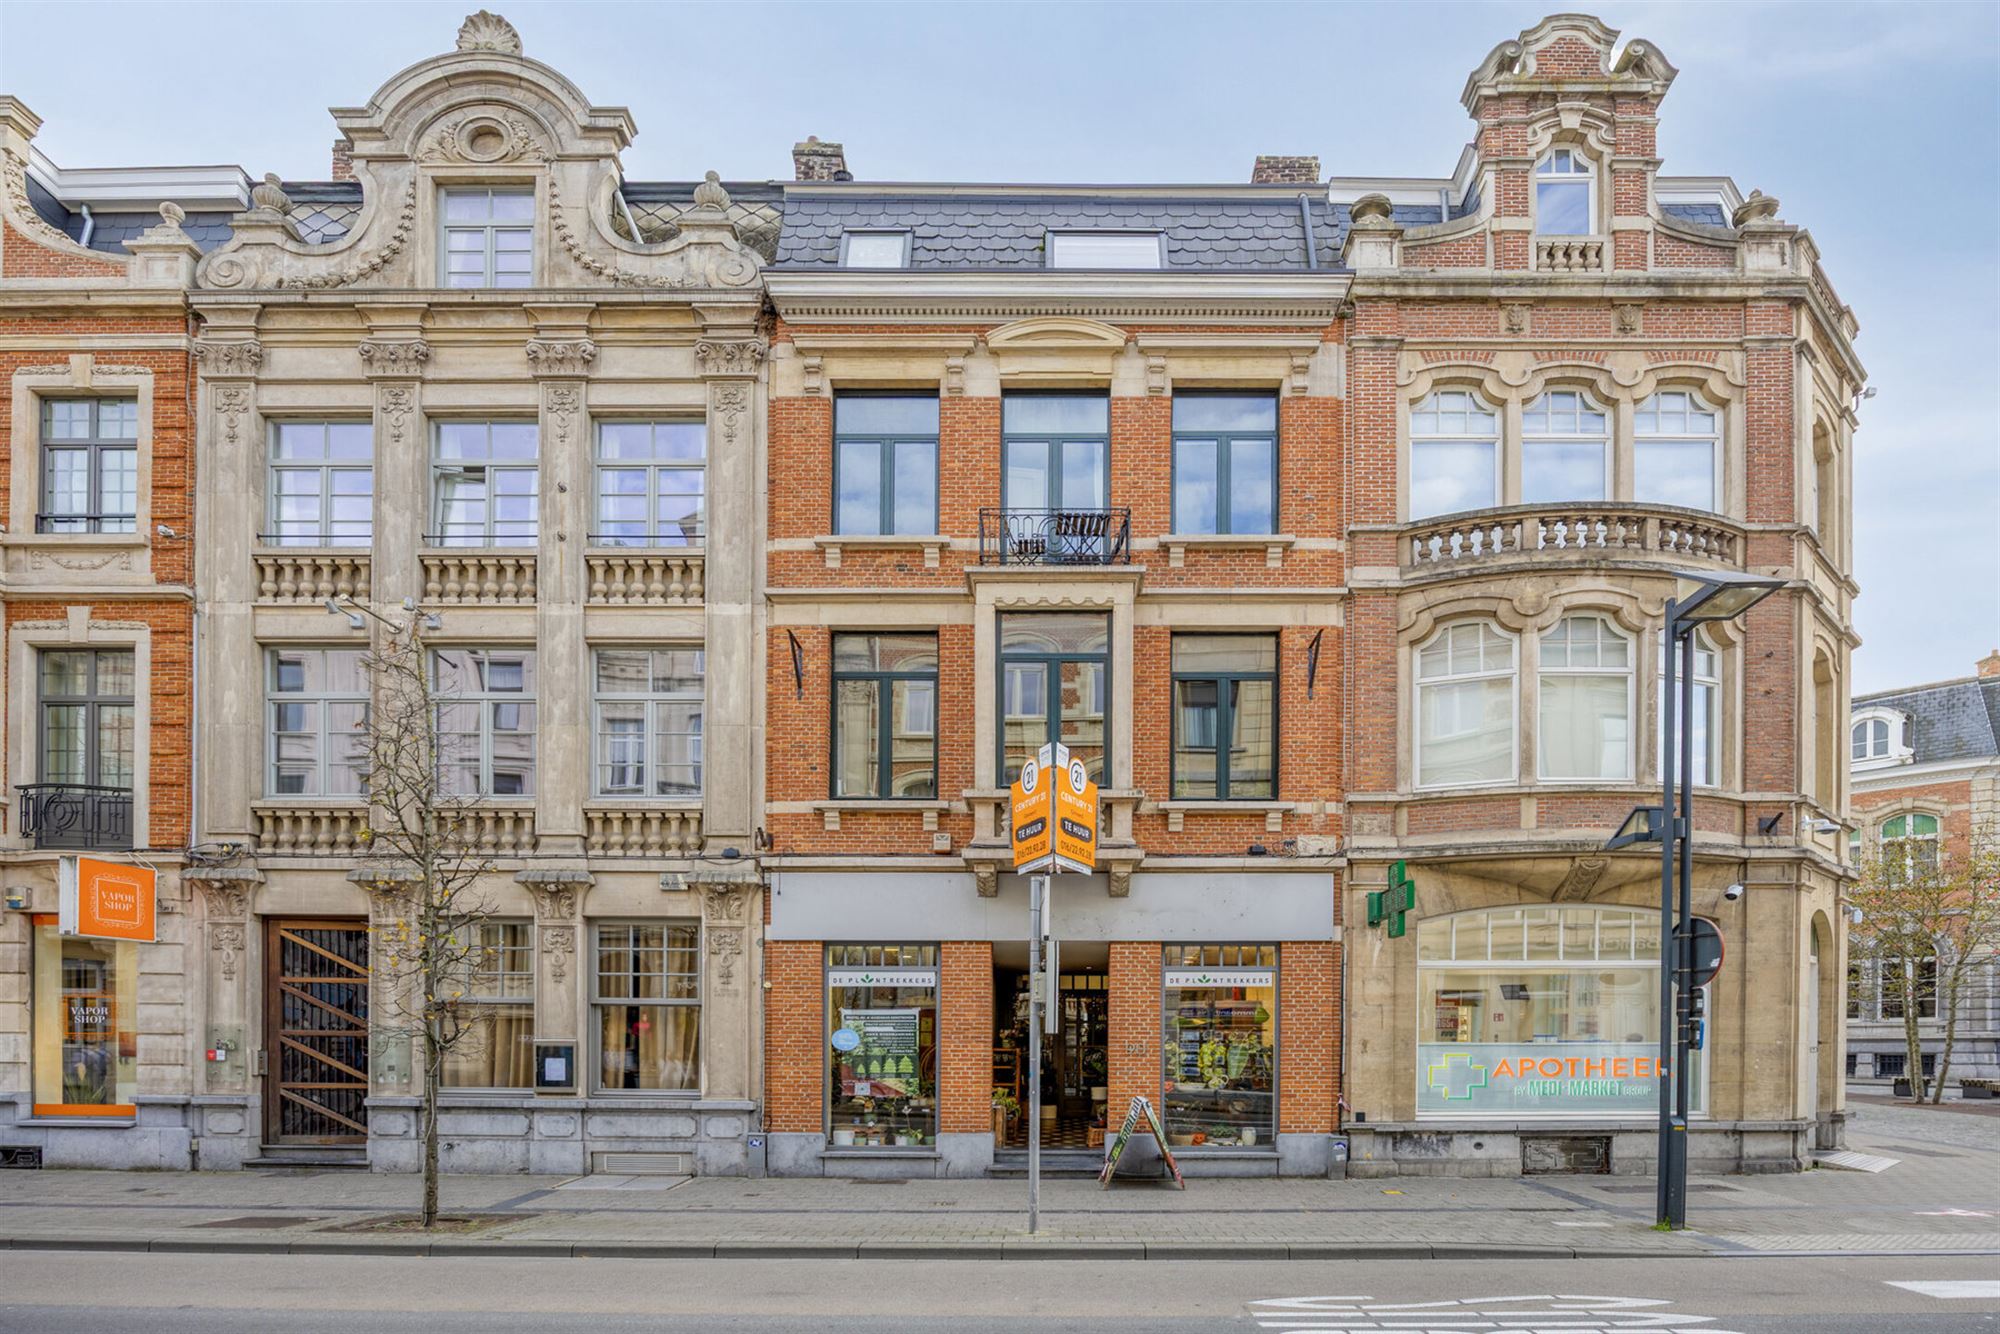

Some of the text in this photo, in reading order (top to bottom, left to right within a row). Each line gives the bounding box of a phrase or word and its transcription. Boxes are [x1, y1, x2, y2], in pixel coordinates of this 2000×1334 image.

[1015, 794, 1041, 813] CENTURY
[1061, 791, 1087, 809] CENTURY
[1018, 822, 1042, 839] TE HUUR
[1064, 820, 1090, 839] TE HUUR
[101, 890, 135, 904] VAPOR
[104, 900, 133, 912] SHOP
[71, 1006, 108, 1015] VAPOR
[74, 1015, 106, 1024] SHOP
